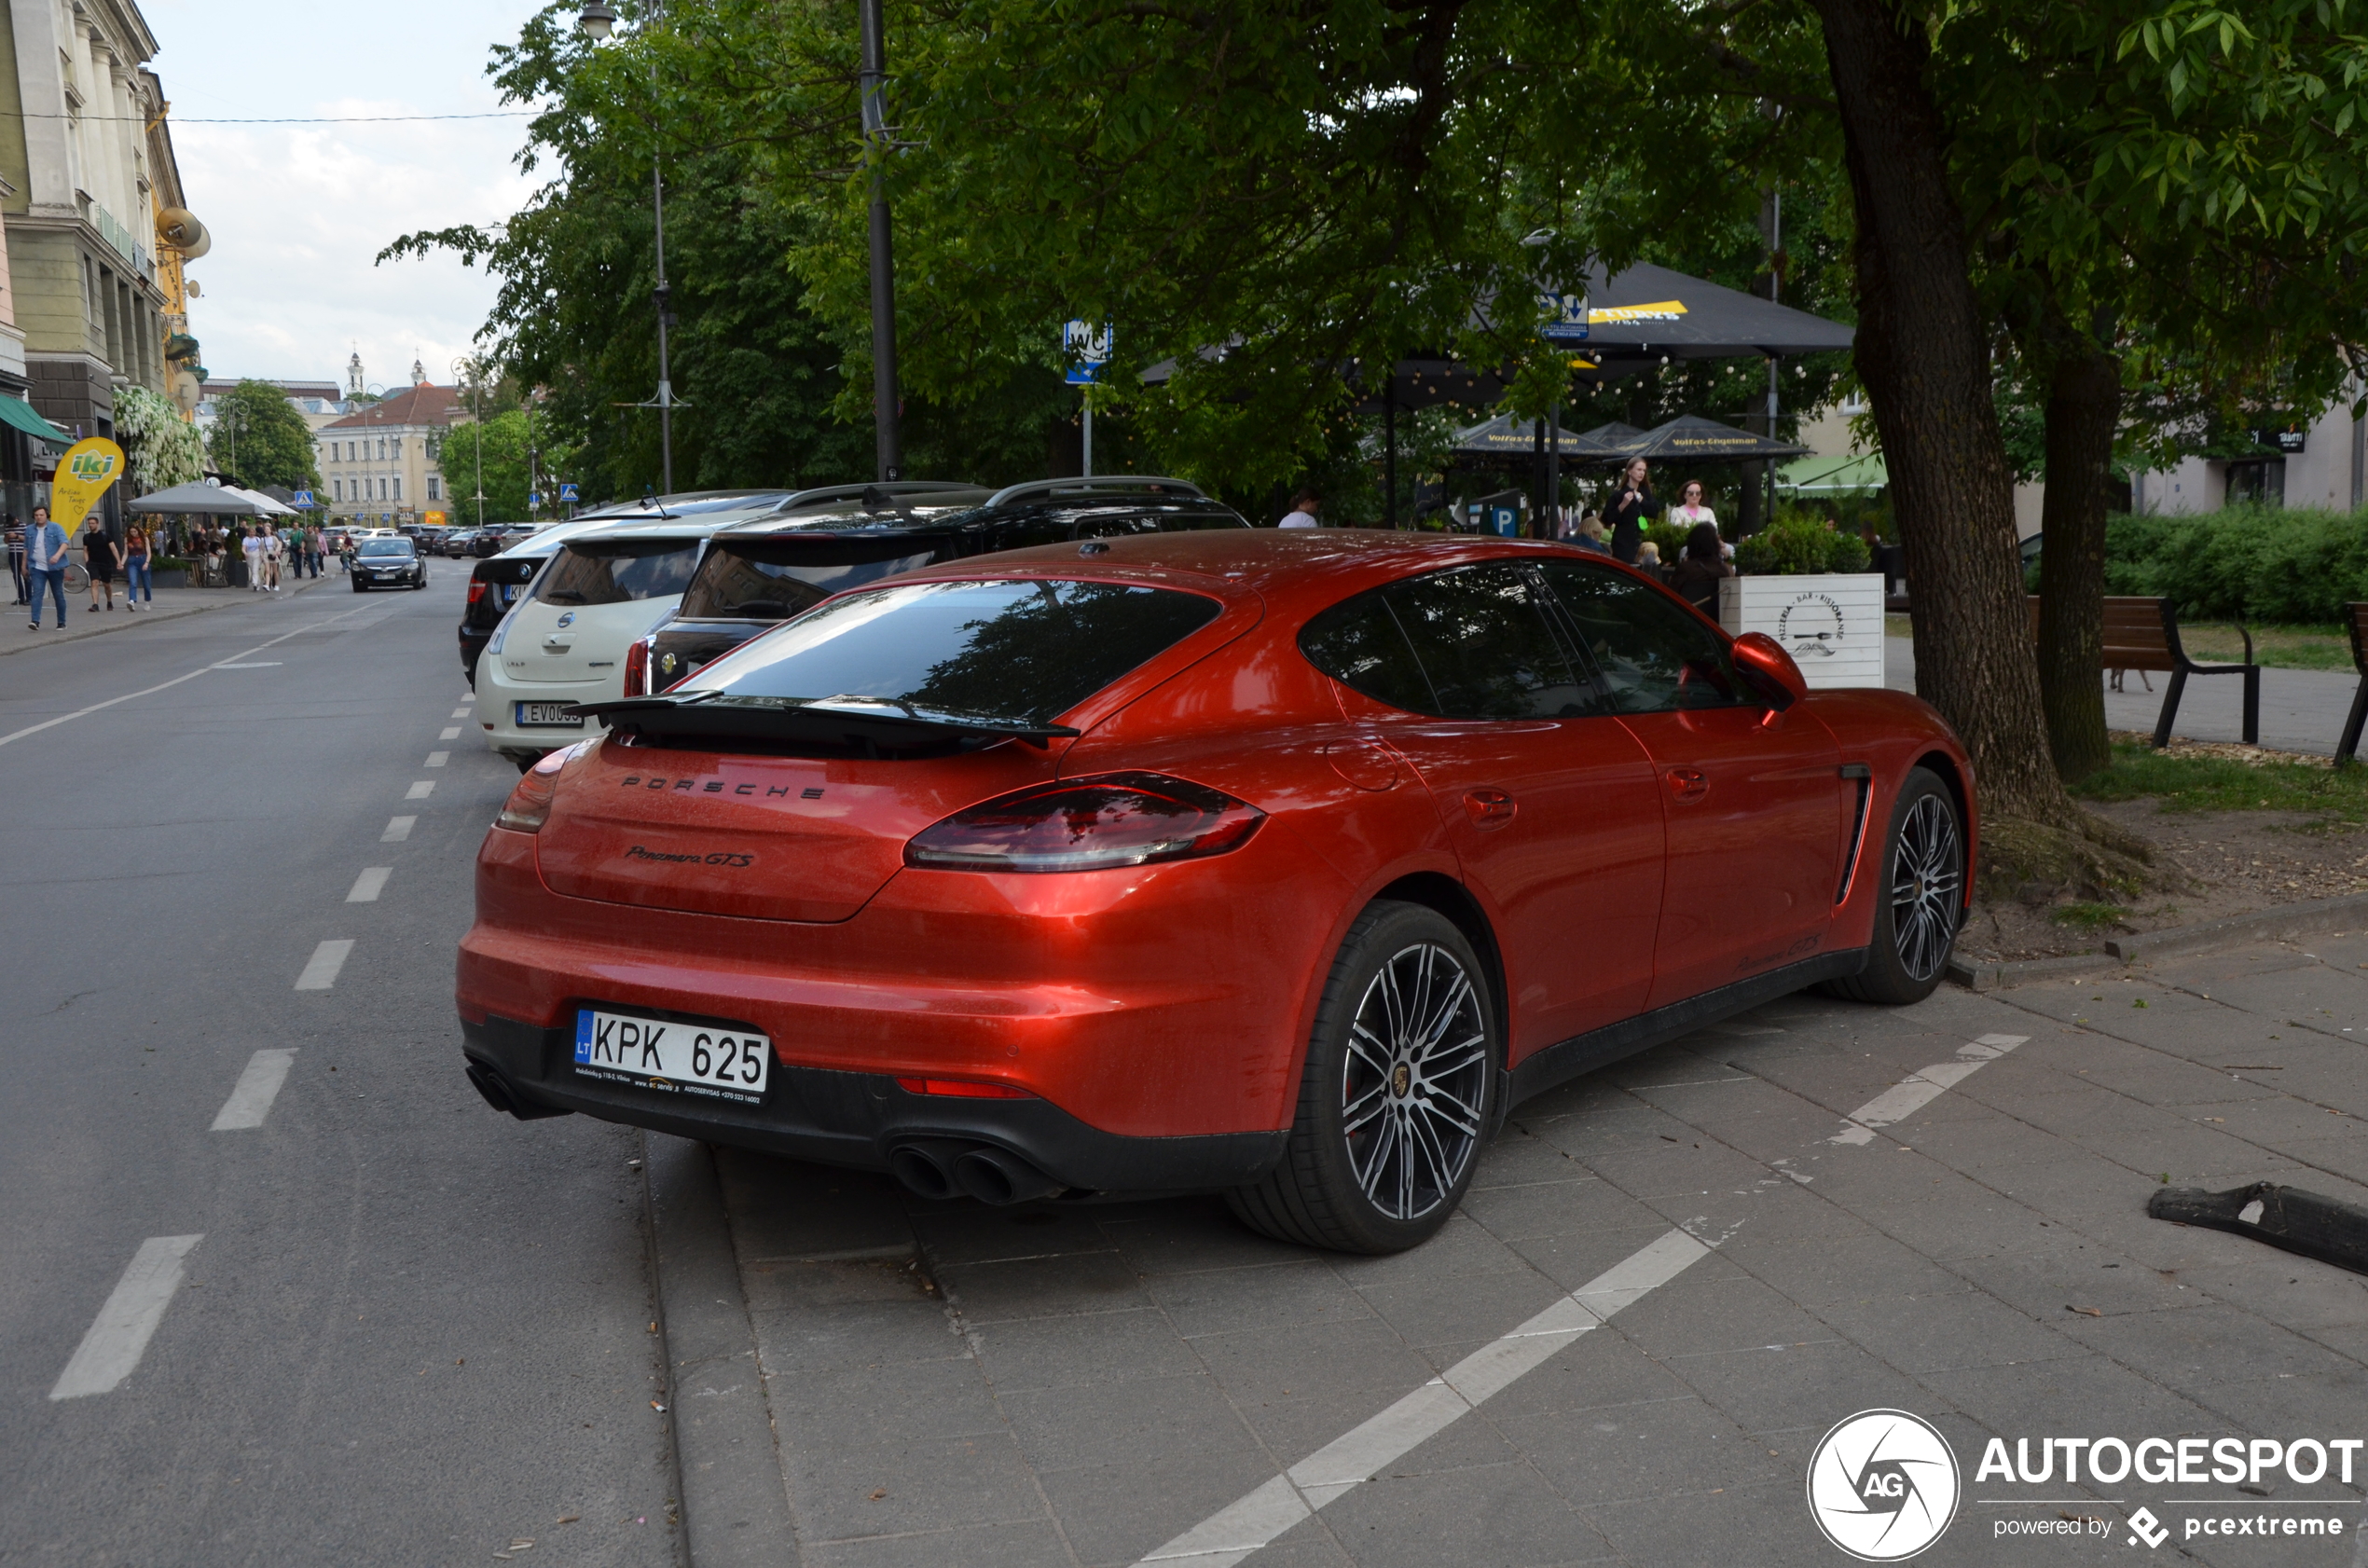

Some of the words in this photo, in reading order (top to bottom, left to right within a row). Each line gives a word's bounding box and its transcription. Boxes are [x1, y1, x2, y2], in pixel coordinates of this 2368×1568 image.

[1070, 333, 1105, 351] WC
[72, 455, 114, 473] iki
[1498, 510, 1512, 534] P
[1779, 606, 1793, 641] PIZZERIA
[1797, 592, 1813, 603] BAR
[621, 776, 825, 800] PORSCHE
[625, 846, 702, 863] Panamera
[705, 852, 754, 868] GTS
[577, 1041, 590, 1055] LT
[594, 1017, 667, 1071] KPK
[692, 1033, 762, 1084] 625
[684, 1085, 721, 1097] AUTOSERVISAS
